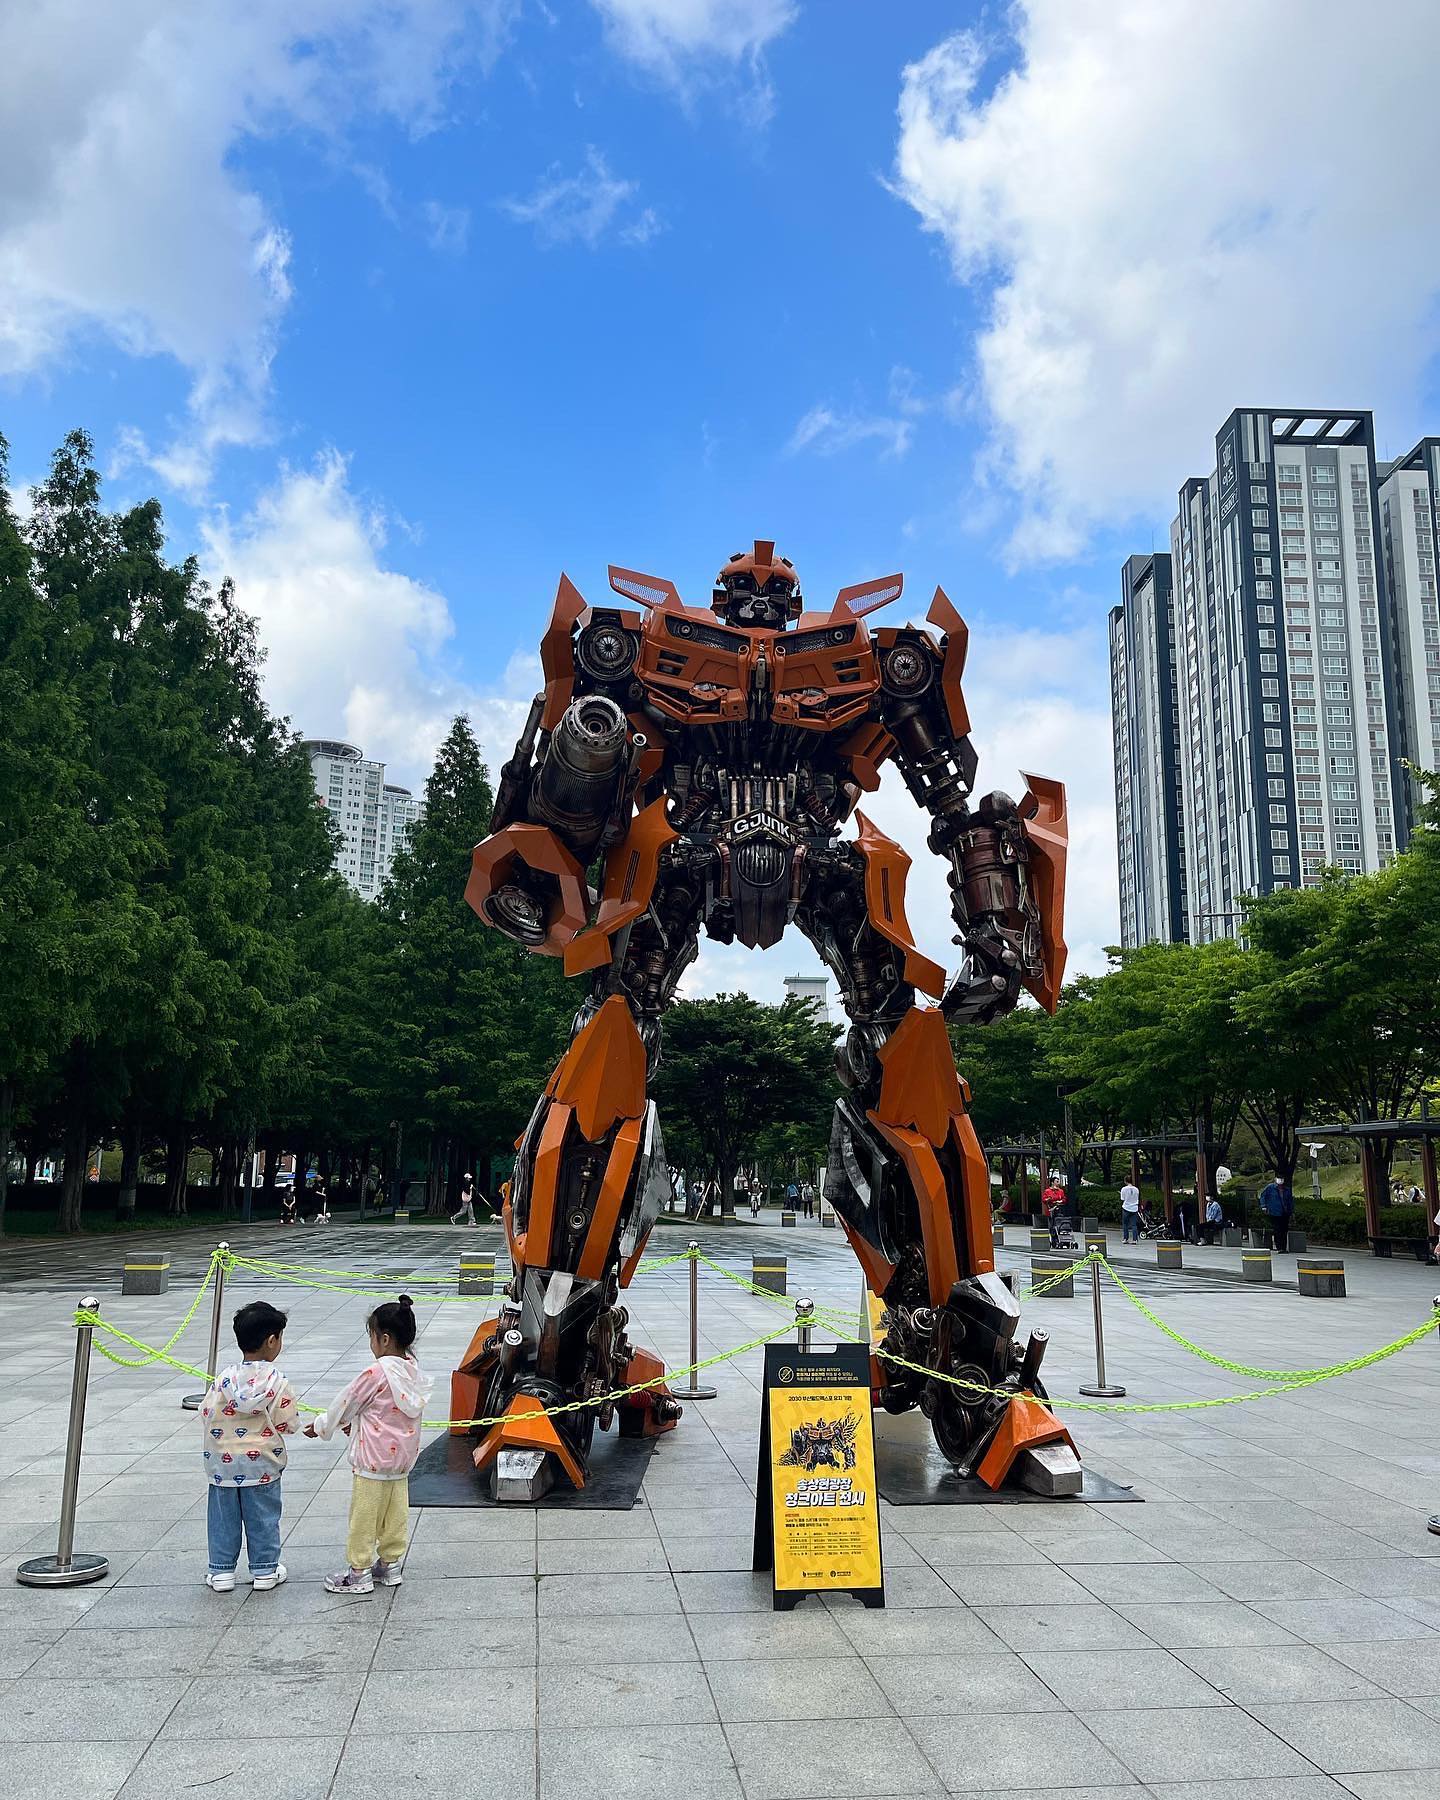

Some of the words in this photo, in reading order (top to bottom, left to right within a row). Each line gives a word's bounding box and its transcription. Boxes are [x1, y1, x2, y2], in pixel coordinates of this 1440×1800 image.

[797, 1478, 852, 1491] 송상현광장
[785, 1492, 836, 1507] 정크아트
[839, 1491, 865, 1507] 전시
